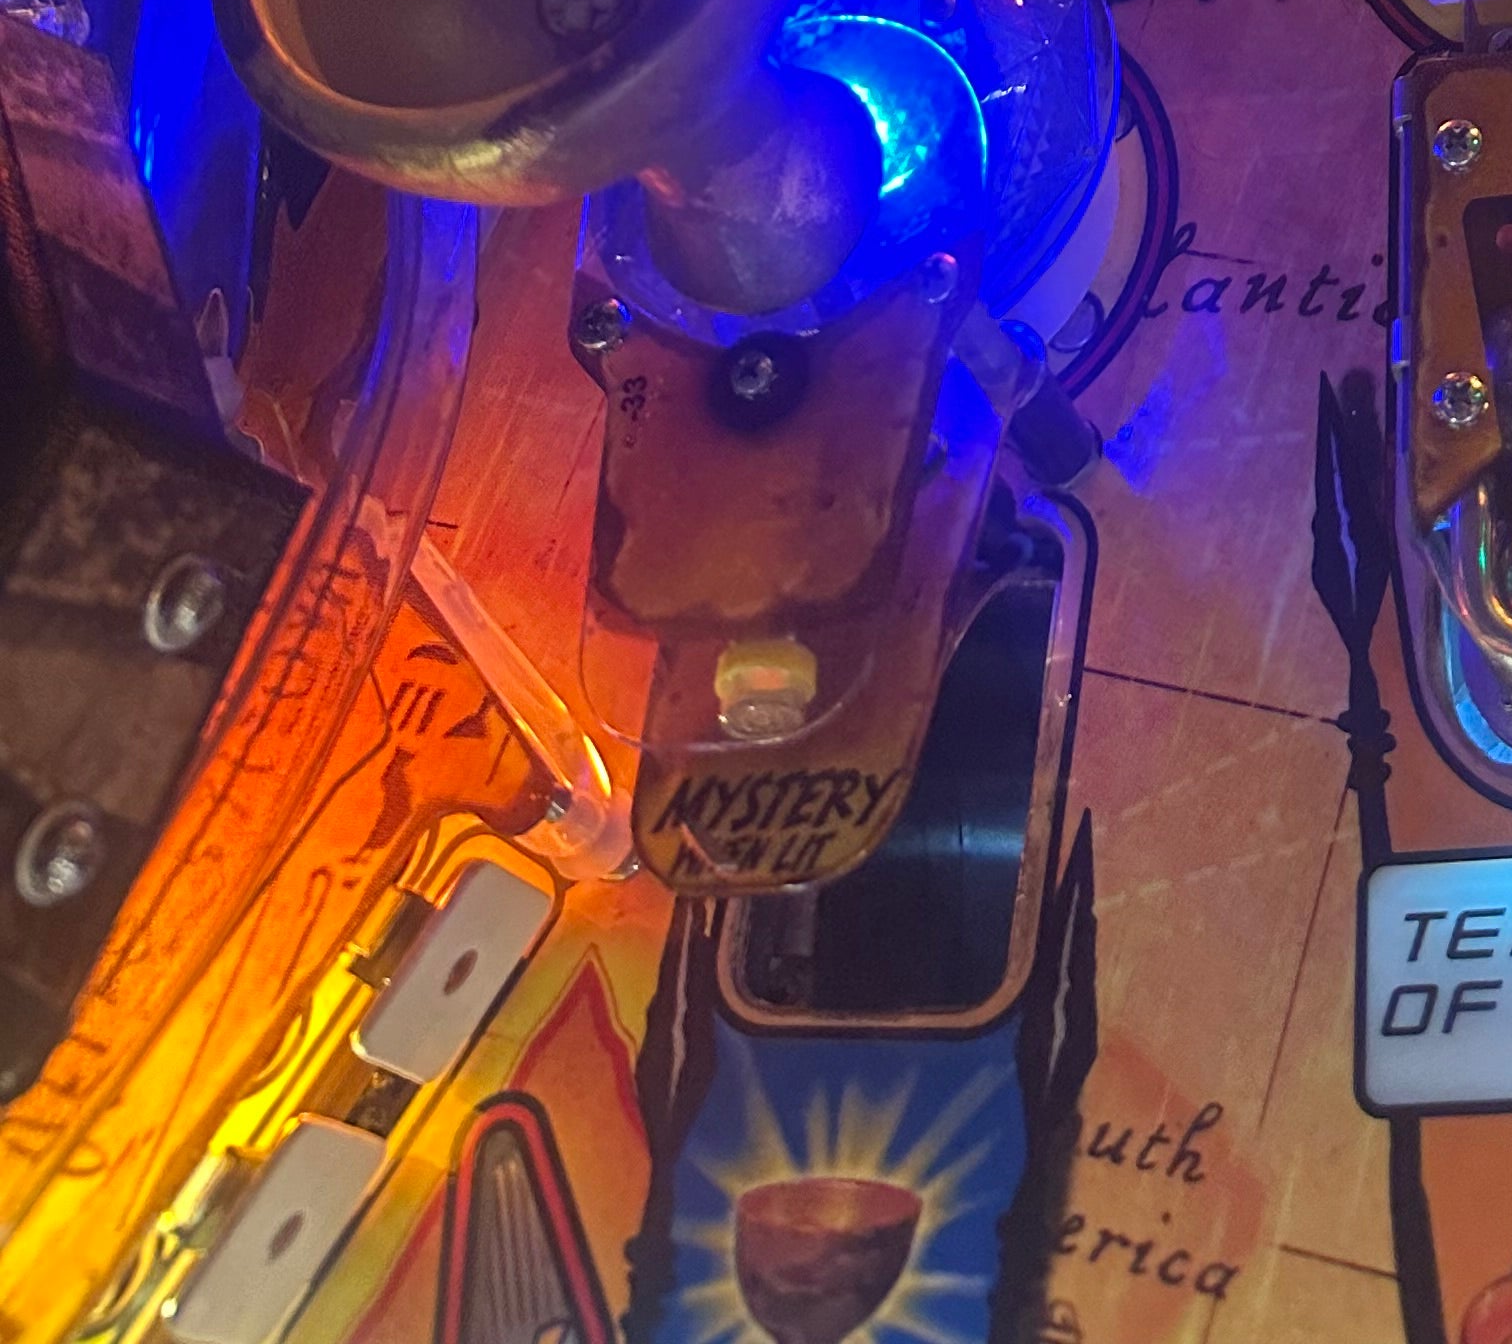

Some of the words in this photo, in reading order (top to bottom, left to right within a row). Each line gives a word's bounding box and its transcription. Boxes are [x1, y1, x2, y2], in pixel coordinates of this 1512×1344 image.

[651, 767, 903, 834] MYSTERY
[771, 830, 839, 874] LIT
[1381, 979, 1504, 1037] OF
